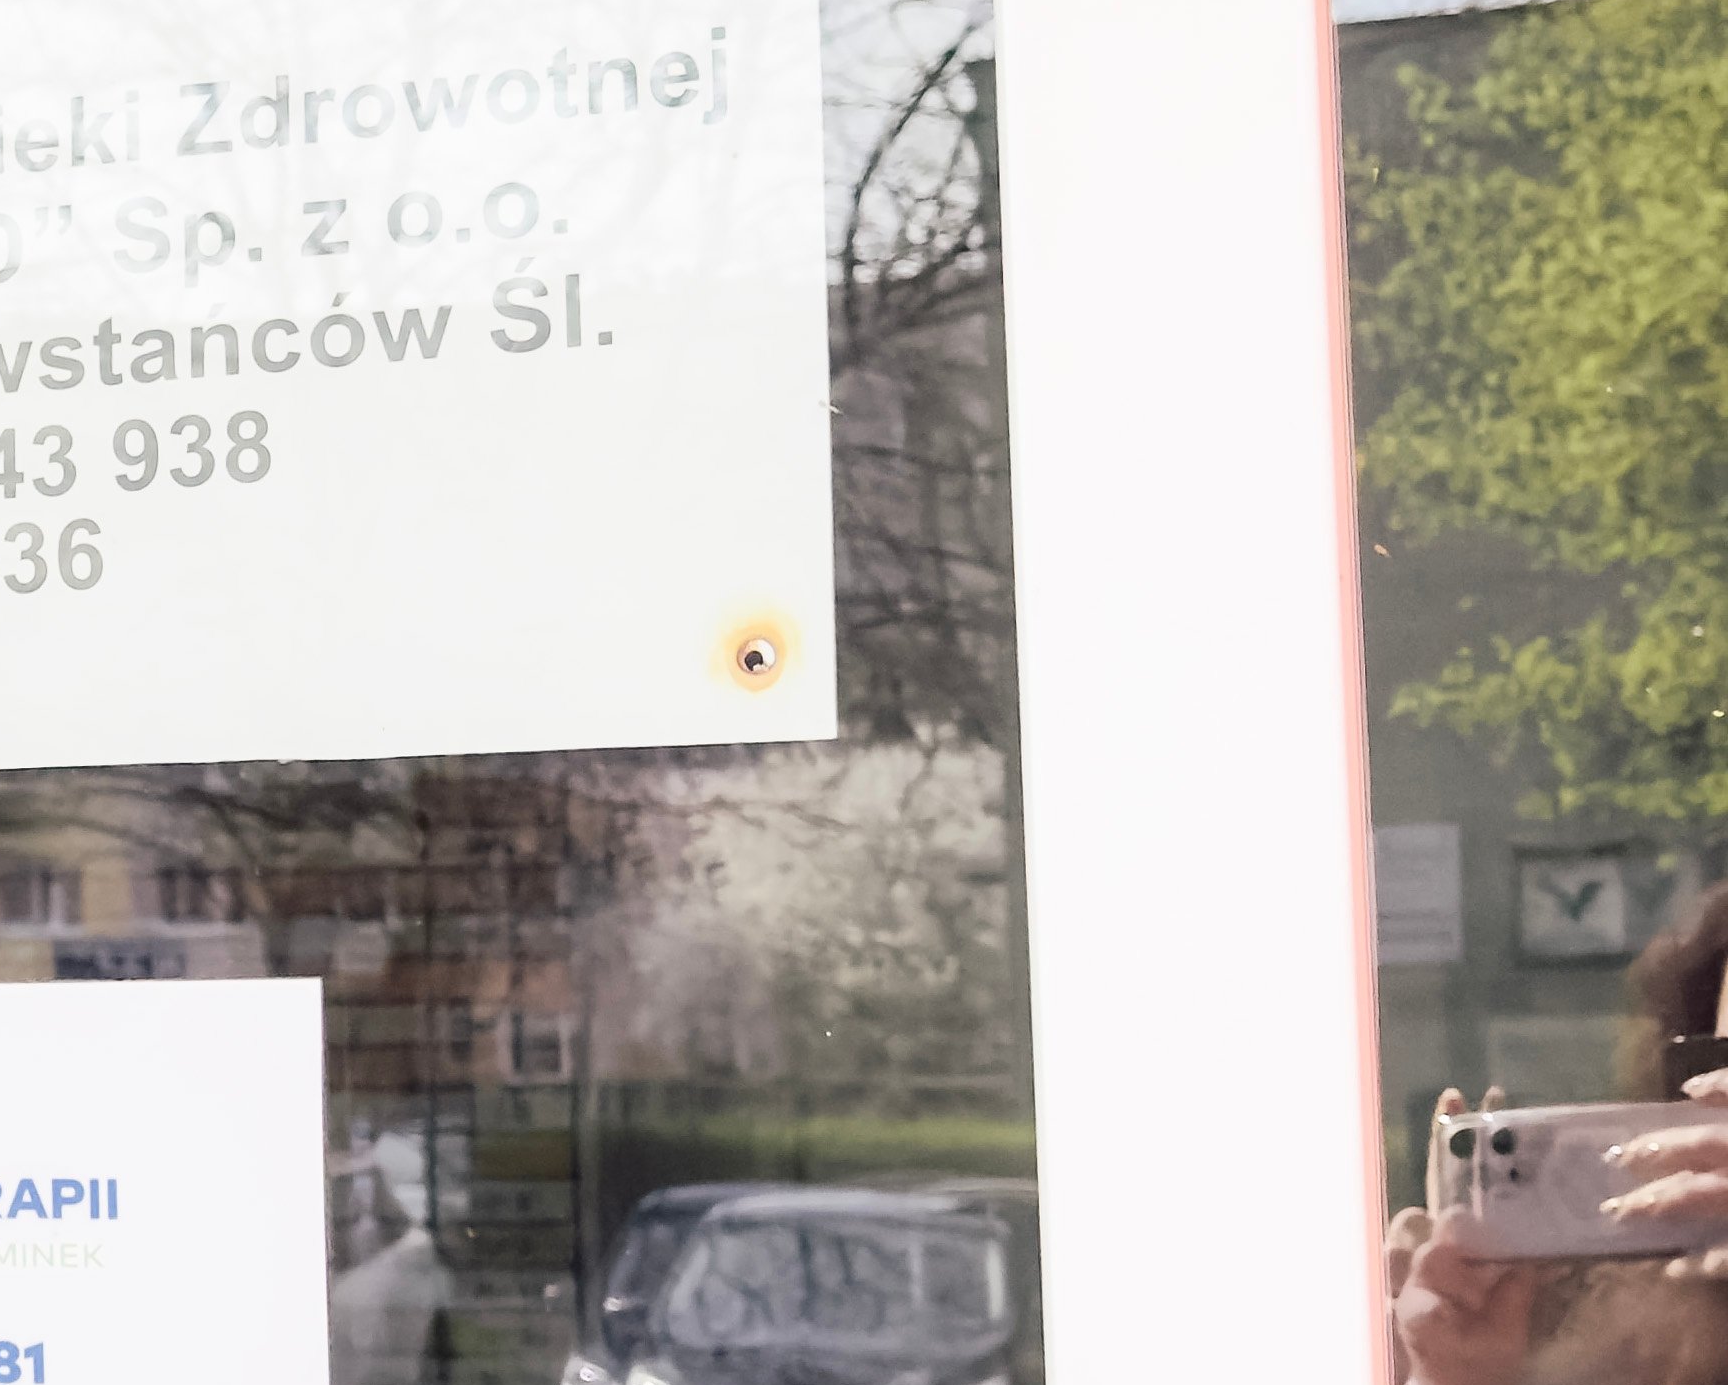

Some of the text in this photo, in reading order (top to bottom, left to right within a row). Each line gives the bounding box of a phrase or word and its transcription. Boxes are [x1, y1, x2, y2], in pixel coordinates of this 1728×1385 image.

[177, 25, 728, 156] Zdrowotnej
[115, 198, 264, 286] Sp.
[301, 197, 351, 257] z
[386, 181, 567, 244] o.o.
[490, 272, 614, 354] Śl.
[112, 409, 272, 493] 938
